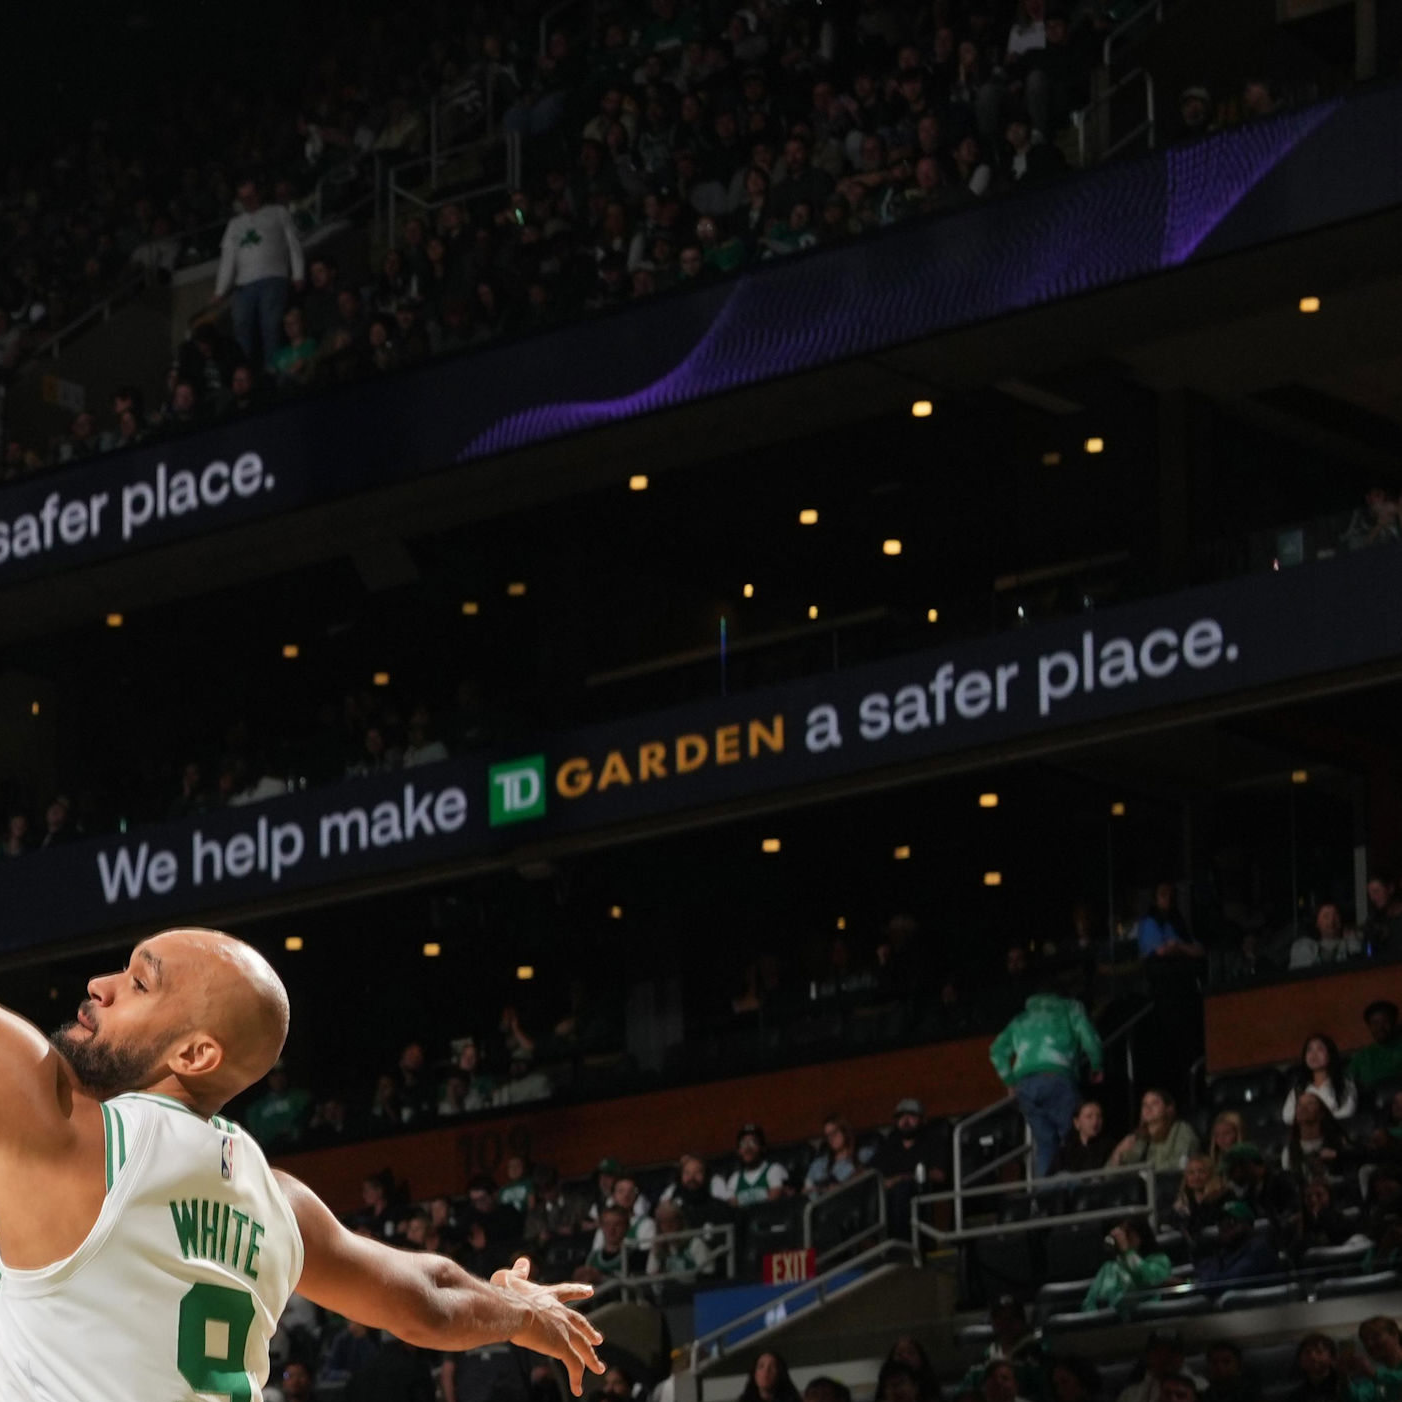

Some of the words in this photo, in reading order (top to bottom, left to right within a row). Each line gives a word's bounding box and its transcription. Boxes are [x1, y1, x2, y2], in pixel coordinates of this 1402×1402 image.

[120, 448, 277, 541] place.
[97, 841, 177, 905] We
[192, 810, 307, 893] help
[317, 785, 468, 862] make
[495, 764, 542, 818] TD
[556, 714, 786, 799] GARDEN
[805, 702, 843, 752] a
[858, 653, 1018, 741] safer
[1036, 617, 1238, 716] place.
[169, 1197, 265, 1281] WHITE
[772, 1254, 807, 1285] EXIT
